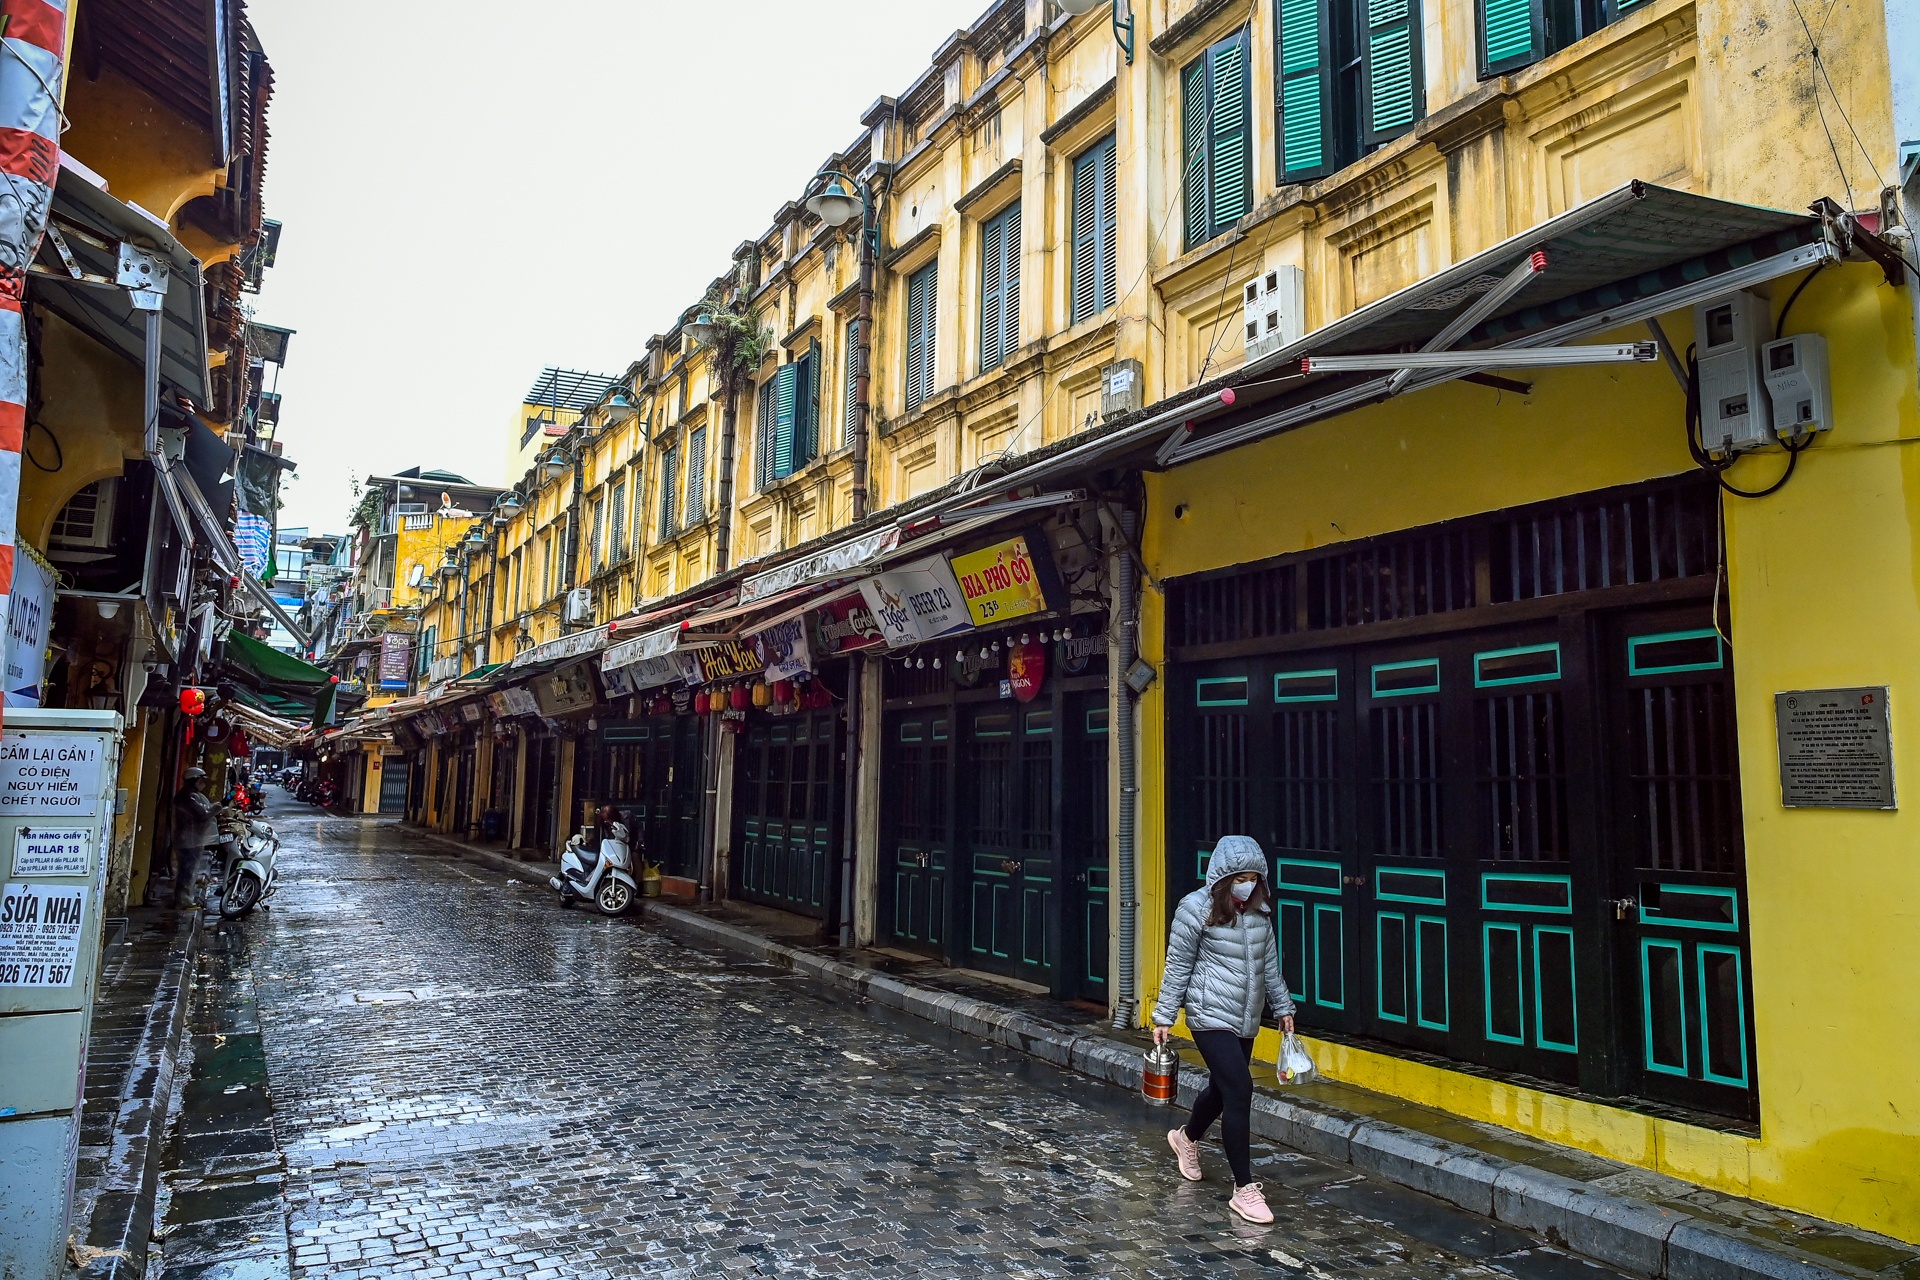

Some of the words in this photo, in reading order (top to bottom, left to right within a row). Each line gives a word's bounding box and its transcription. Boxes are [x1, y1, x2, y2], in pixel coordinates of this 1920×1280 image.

[960, 573, 988, 600] BIA
[986, 551, 1011, 593] PHỐ
[1010, 543, 1032, 586] CỔ
[909, 591, 935, 617] BEER
[934, 587, 952, 611] 23
[878, 602, 909, 633] Tiger
[1001, 682, 1011, 695] 23
[1, 742, 29, 760] CẤM
[33, 748, 54, 764] LẠI
[58, 744, 86, 762] GẦN
[18, 765, 38, 777] CÓ
[41, 765, 70, 780] ĐIỆN
[7, 781, 45, 791] NGUY
[47, 778, 78, 791] HIỂM
[1, 793, 37, 805] CHẾT
[40, 795, 81, 806] NGƯỜI
[39, 832, 61, 840] HÀNG
[27, 845, 64, 854] PILLAR
[67, 845, 80, 854] 18
[1, 884, 39, 923] SỬA
[43, 892, 81, 924] NHÀ
[0, 923, 13, 933] 0926
[14, 924, 25, 933] 721
[26, 924, 37, 933] 567
[42, 925, 56, 934] 0926
[57, 925, 67, 934] 721
[68, 925, 79, 934] 567
[23, 964, 45, 984] 721
[48, 964, 72, 984] 567
